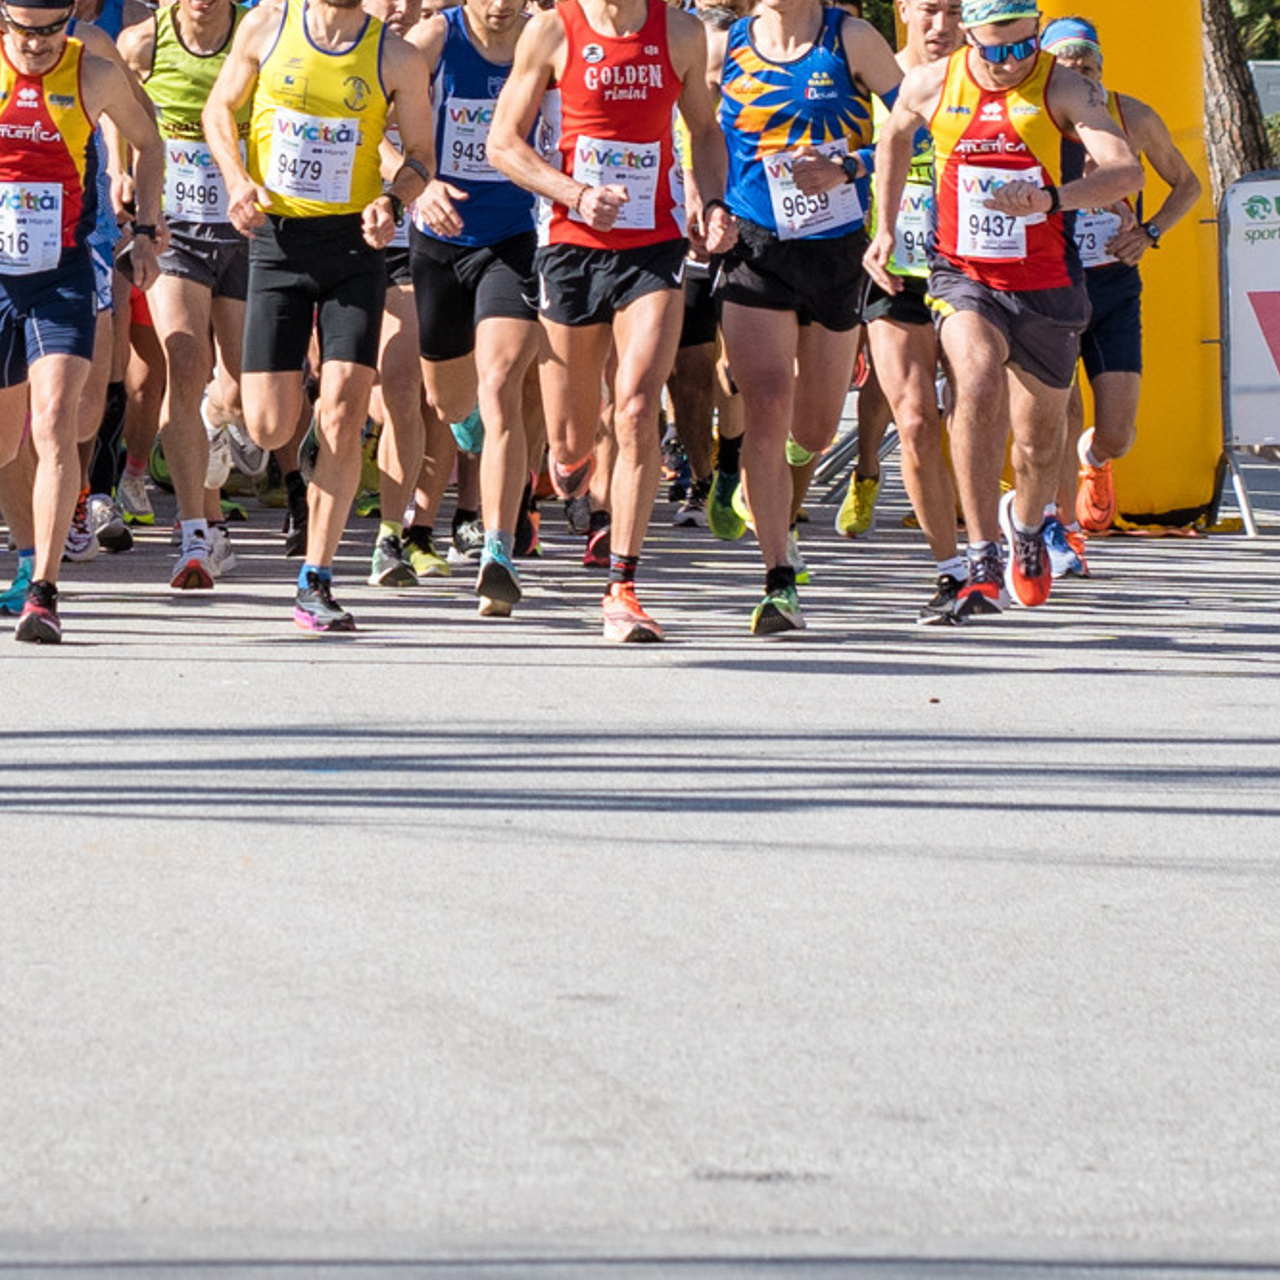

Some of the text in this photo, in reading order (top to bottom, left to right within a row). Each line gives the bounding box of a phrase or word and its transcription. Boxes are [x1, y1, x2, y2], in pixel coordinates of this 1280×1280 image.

[584, 64, 663, 91] GOLDEN
[604, 85, 647, 101] rimini
[278, 119, 352, 144] vivicittà
[278, 153, 323, 181] 9479
[580, 147, 655, 169] vivicittà
[176, 182, 218, 205] 9496
[783, 193, 829, 218] 9659
[969, 214, 1017, 237] 9437
